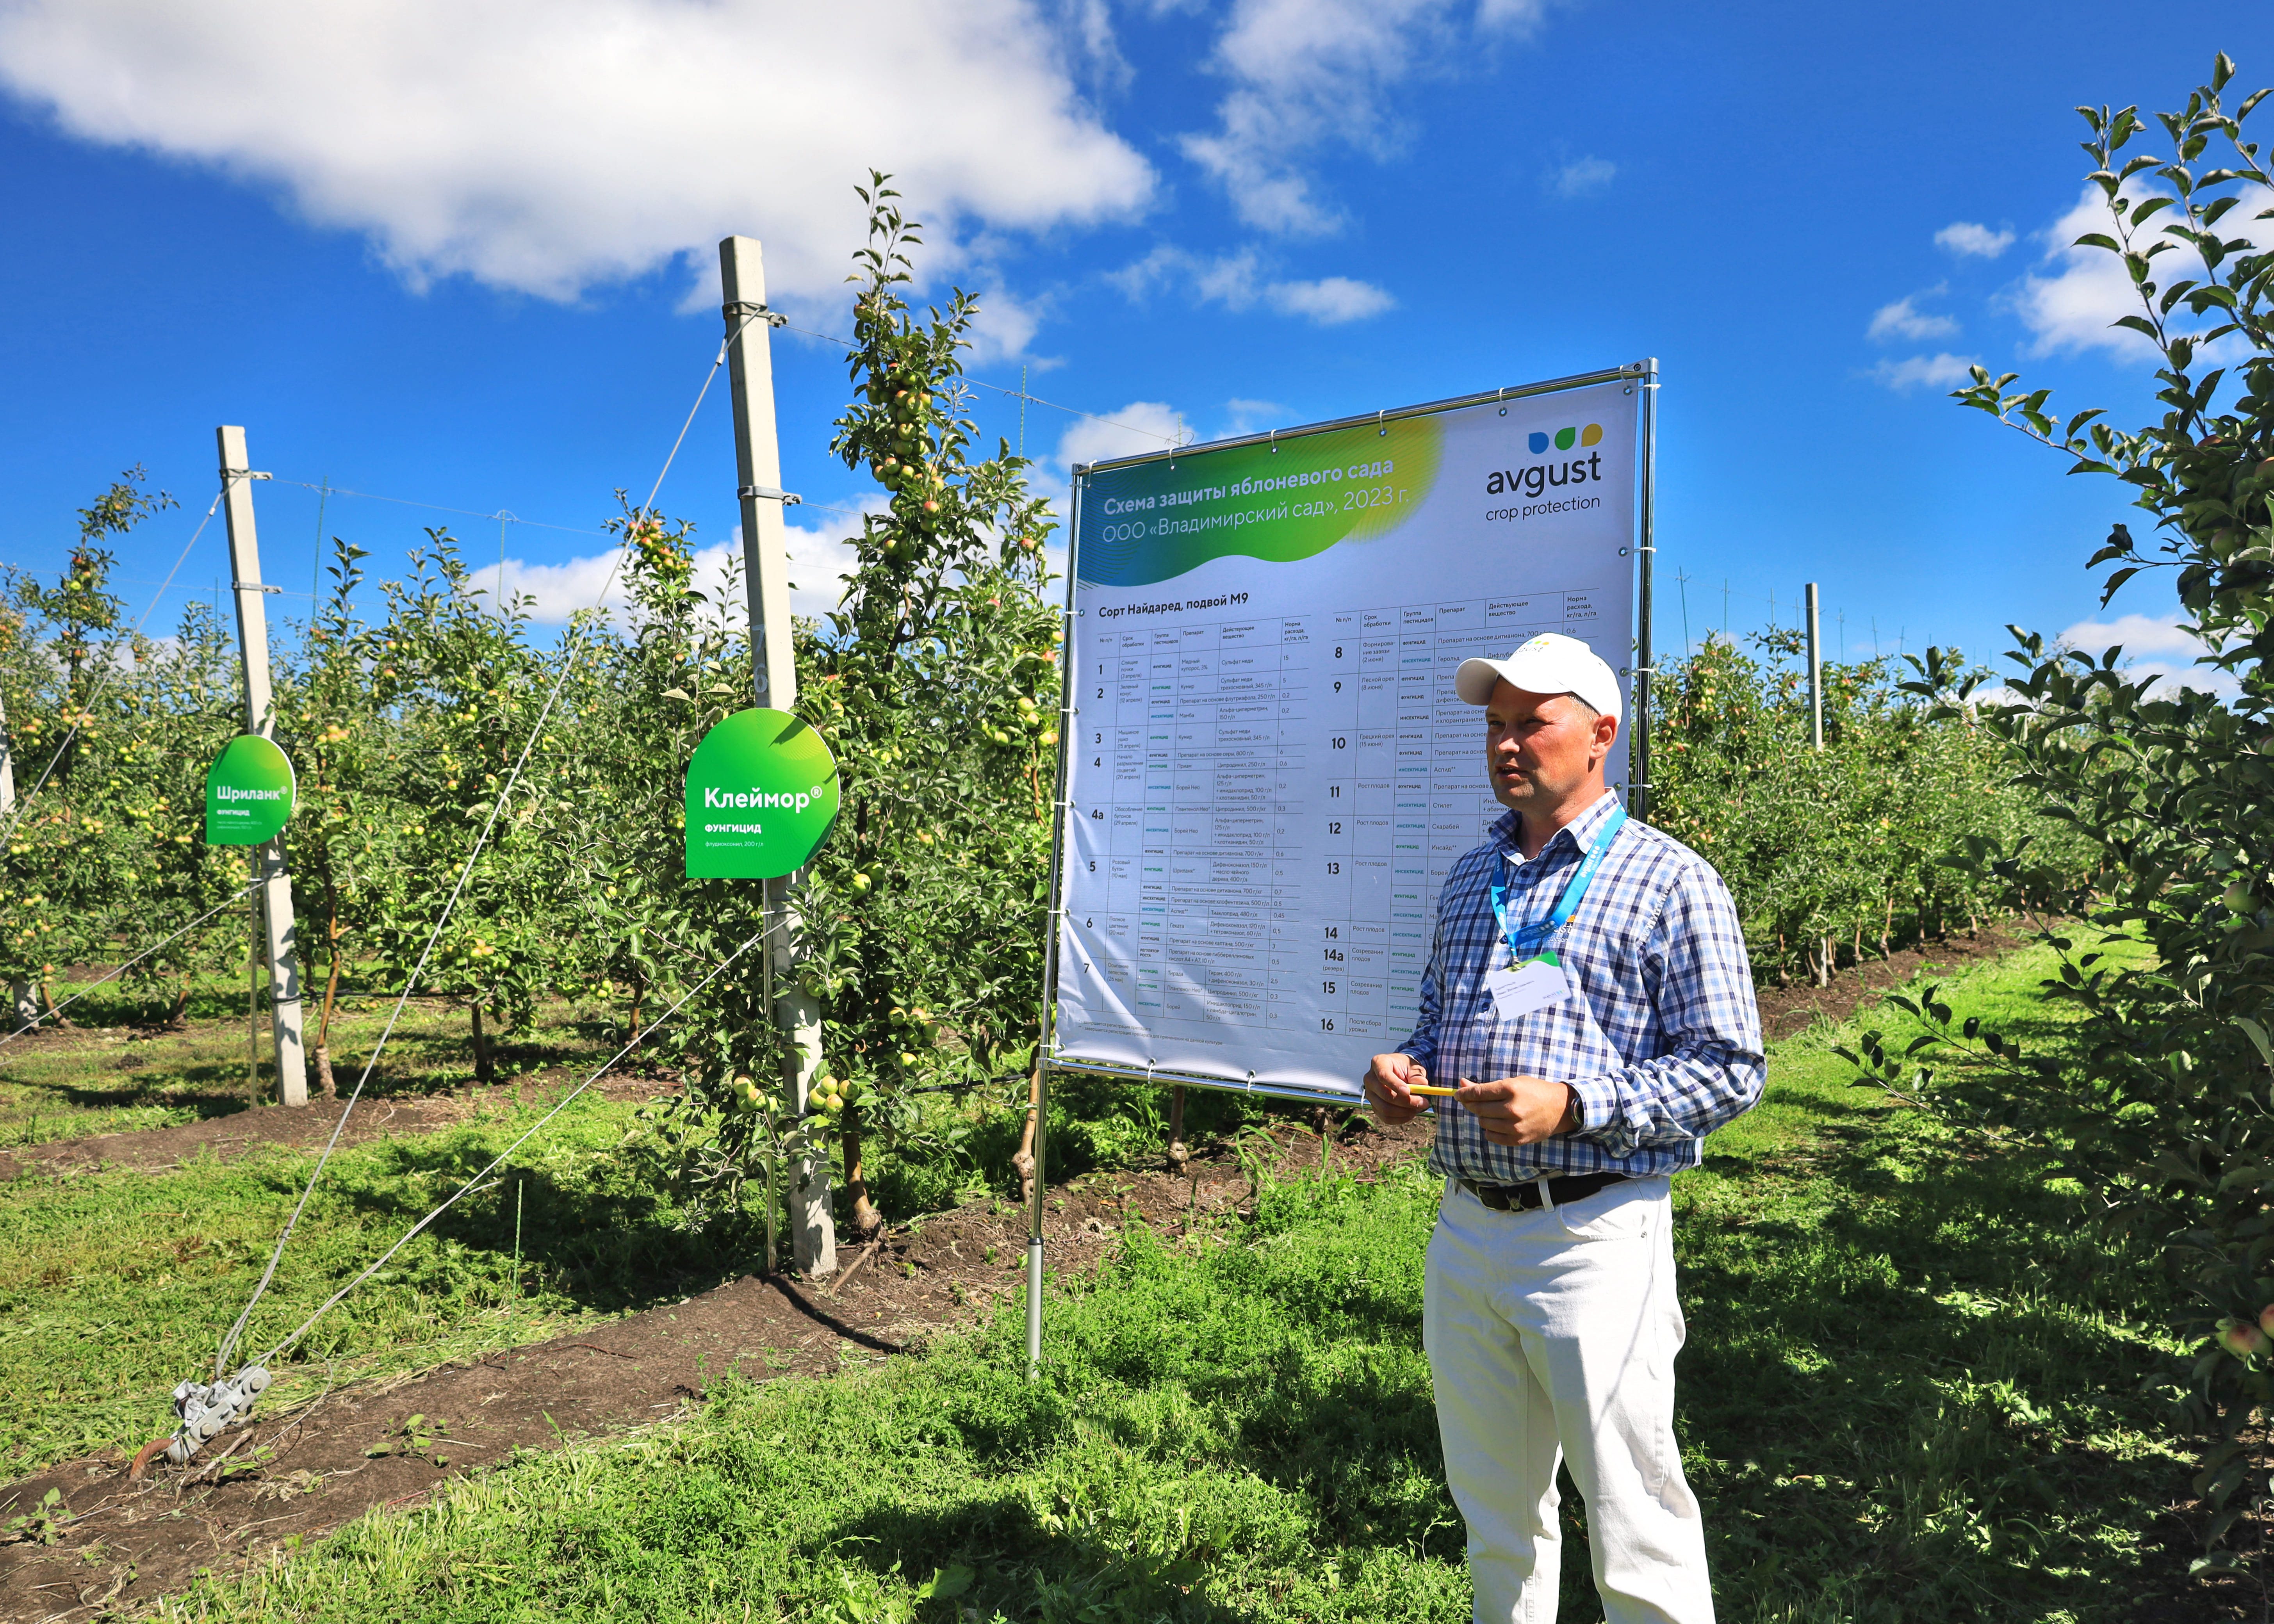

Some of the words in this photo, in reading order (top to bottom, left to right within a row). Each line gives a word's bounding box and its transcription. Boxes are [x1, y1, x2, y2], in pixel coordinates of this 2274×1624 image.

[1487, 451, 1601, 498] avgust
[1104, 497, 1155, 515] Схема
[1160, 486, 1225, 507] защиты
[1231, 468, 1342, 497] яблоневого
[1348, 460, 1392, 479] сада
[1103, 522, 1145, 542] ООО
[1148, 500, 1287, 535] «Владимирский
[1293, 501, 1337, 517] сад»,
[1344, 486, 1392, 510] 2023
[1399, 490, 1408, 502] г.
[1486, 508, 1518, 522] crop
[1523, 496, 1600, 520] protection
[1099, 607, 1125, 619] Сорт
[1128, 602, 1183, 614] Найдаред,
[1187, 595, 1227, 609] подвой
[1489, 602, 1528, 610] Действующее
[1335, 647, 1342, 658] 8
[1099, 664, 1102, 675] 1
[1097, 688, 1103, 698] 2
[1334, 682, 1341, 693] 9
[1095, 733, 1101, 743] 3
[1332, 737, 1346, 749] 10
[1094, 757, 1100, 767] 4
[1330, 786, 1339, 798] 11
[705, 786, 823, 814] Клеймор®
[1092, 809, 1103, 819] 4а
[705, 824, 761, 833] ФУНГИЦИД
[1329, 822, 1341, 834] 12
[1089, 861, 1096, 872] 5
[1327, 863, 1339, 874] 13
[1580, 859, 1594, 878] avgust
[1087, 917, 1092, 928] 6
[1325, 927, 1337, 939] 14
[1324, 949, 1343, 961] 14а
[1084, 963, 1089, 973] 7
[1323, 965, 1345, 973] (резерв)
[1322, 981, 1335, 994] 15
[1321, 1019, 1333, 1031] 16
